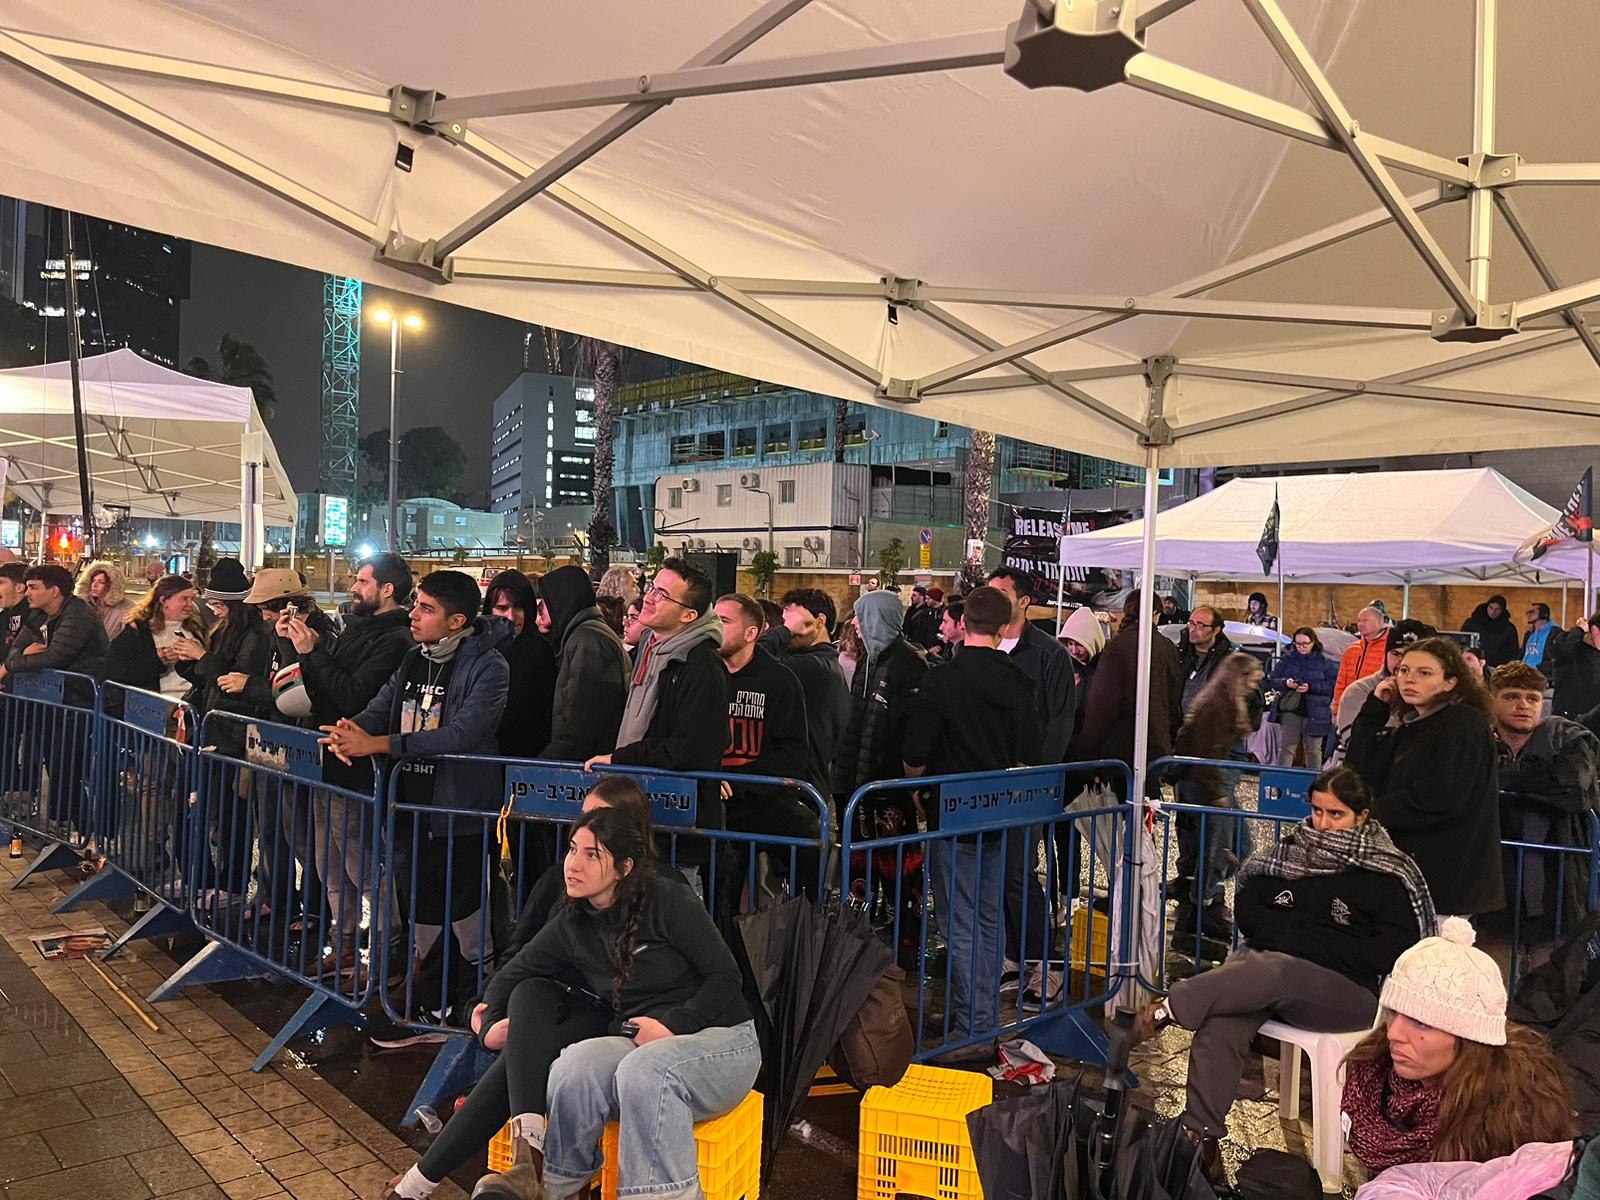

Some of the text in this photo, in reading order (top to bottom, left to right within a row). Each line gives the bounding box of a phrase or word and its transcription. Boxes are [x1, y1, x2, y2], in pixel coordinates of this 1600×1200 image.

[1014, 518, 1064, 538] RELEAS
[736, 690, 766, 707] מחזירים
[511, 781, 691, 811] עיריי אביב-יפו
